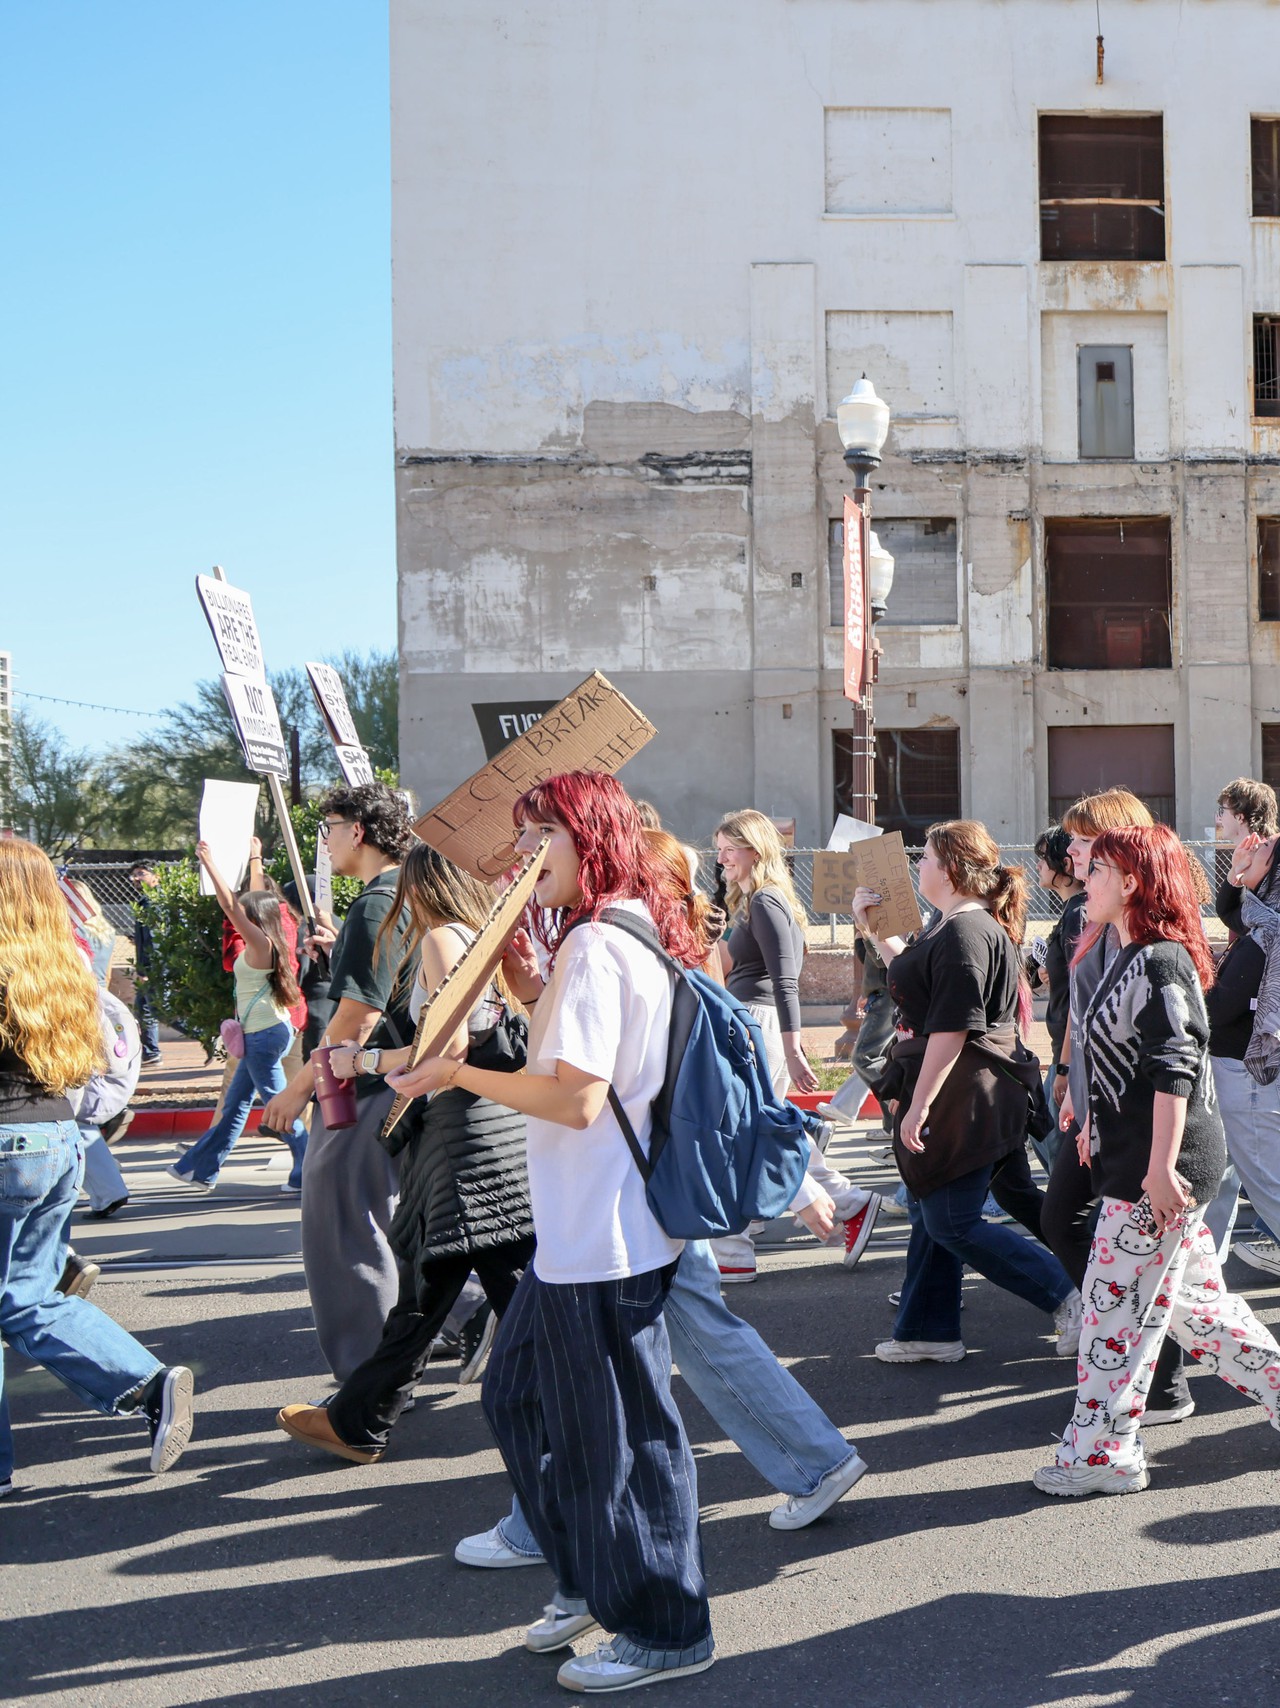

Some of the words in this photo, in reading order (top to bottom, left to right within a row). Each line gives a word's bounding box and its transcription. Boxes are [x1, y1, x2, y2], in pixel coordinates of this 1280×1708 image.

[216, 612, 241, 643] ARE
[238, 620, 257, 650] THE
[222, 642, 243, 664] REAL
[243, 684, 267, 717] NOT
[524, 679, 615, 757] BREAKS
[498, 713, 542, 739] FUC
[890, 877, 916, 928] MURDERS
